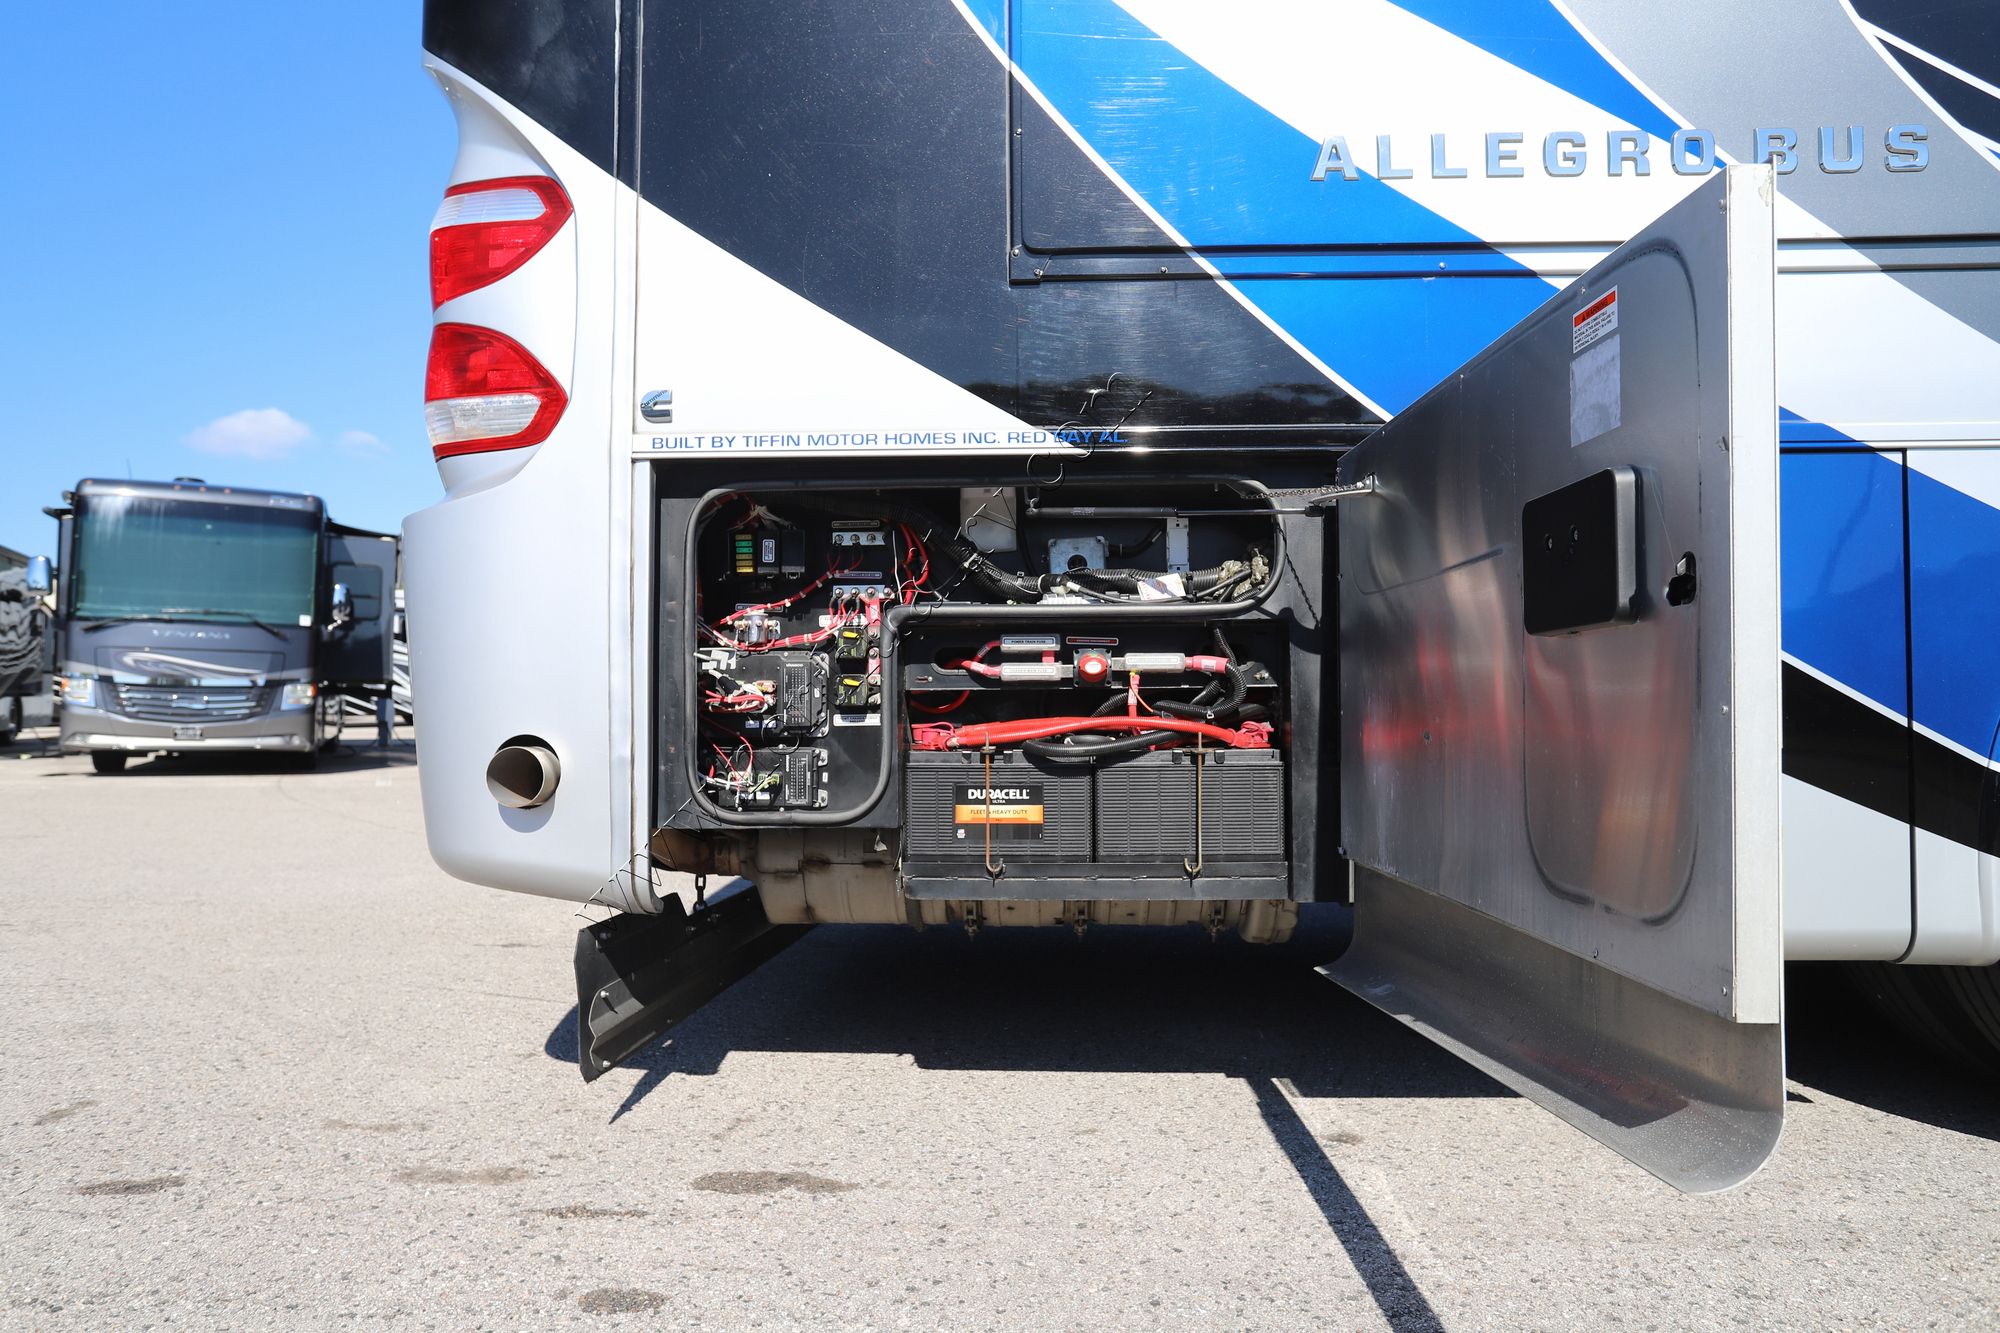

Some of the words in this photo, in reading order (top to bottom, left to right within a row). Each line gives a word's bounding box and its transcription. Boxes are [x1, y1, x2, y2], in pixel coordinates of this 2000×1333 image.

[1309, 128, 1716, 181] ALLEGRO
[1753, 123, 1930, 175] BUS
[652, 436, 704, 449] BUILT
[712, 436, 736, 448] BY
[742, 434, 800, 448] TIFFIN
[808, 434, 878, 446] MOTOR
[885, 432, 956, 445] HOMES
[963, 432, 1000, 444] INC.
[1008, 432, 1046, 444] RED
[1054, 430, 1092, 444] BAY
[1098, 430, 1128, 443] AL.
[968, 788, 1030, 799] DURACELL
